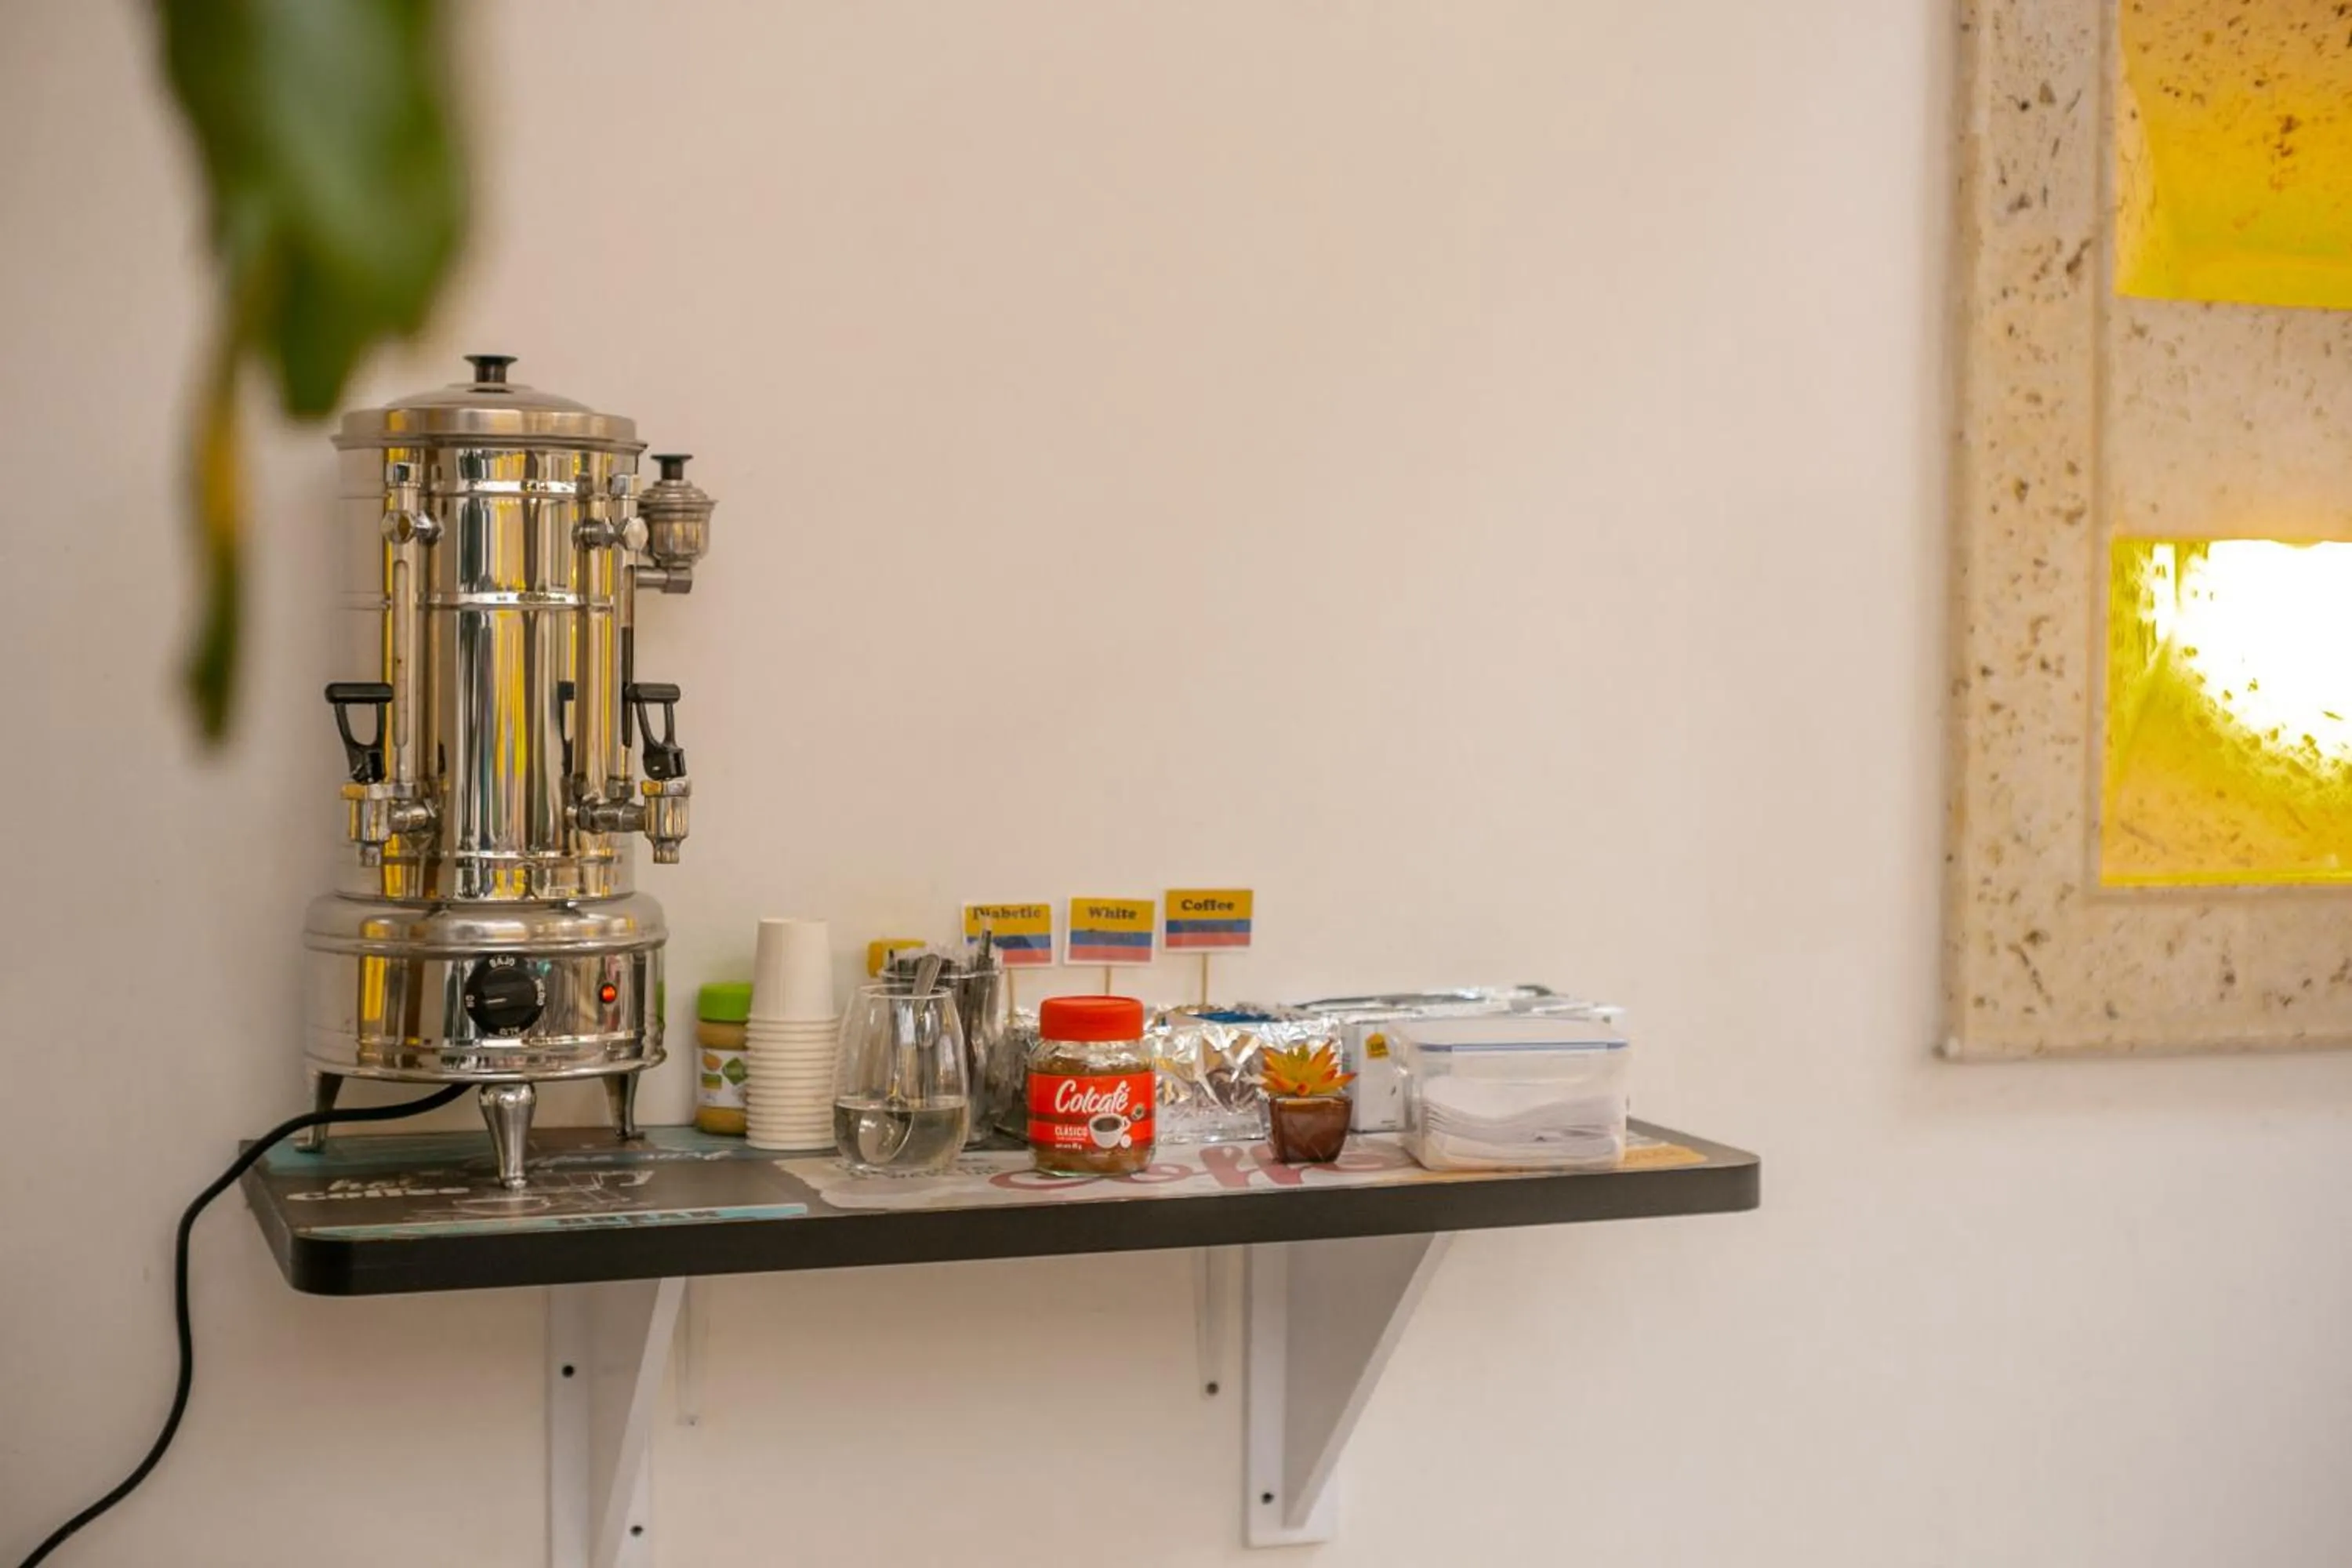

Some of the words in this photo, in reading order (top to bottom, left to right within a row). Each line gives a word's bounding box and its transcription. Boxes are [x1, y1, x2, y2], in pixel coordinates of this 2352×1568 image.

[1181, 898, 1235, 912] Coffee
[1087, 906, 1137, 920] White
[1054, 1079, 1131, 1114] Colcafé
